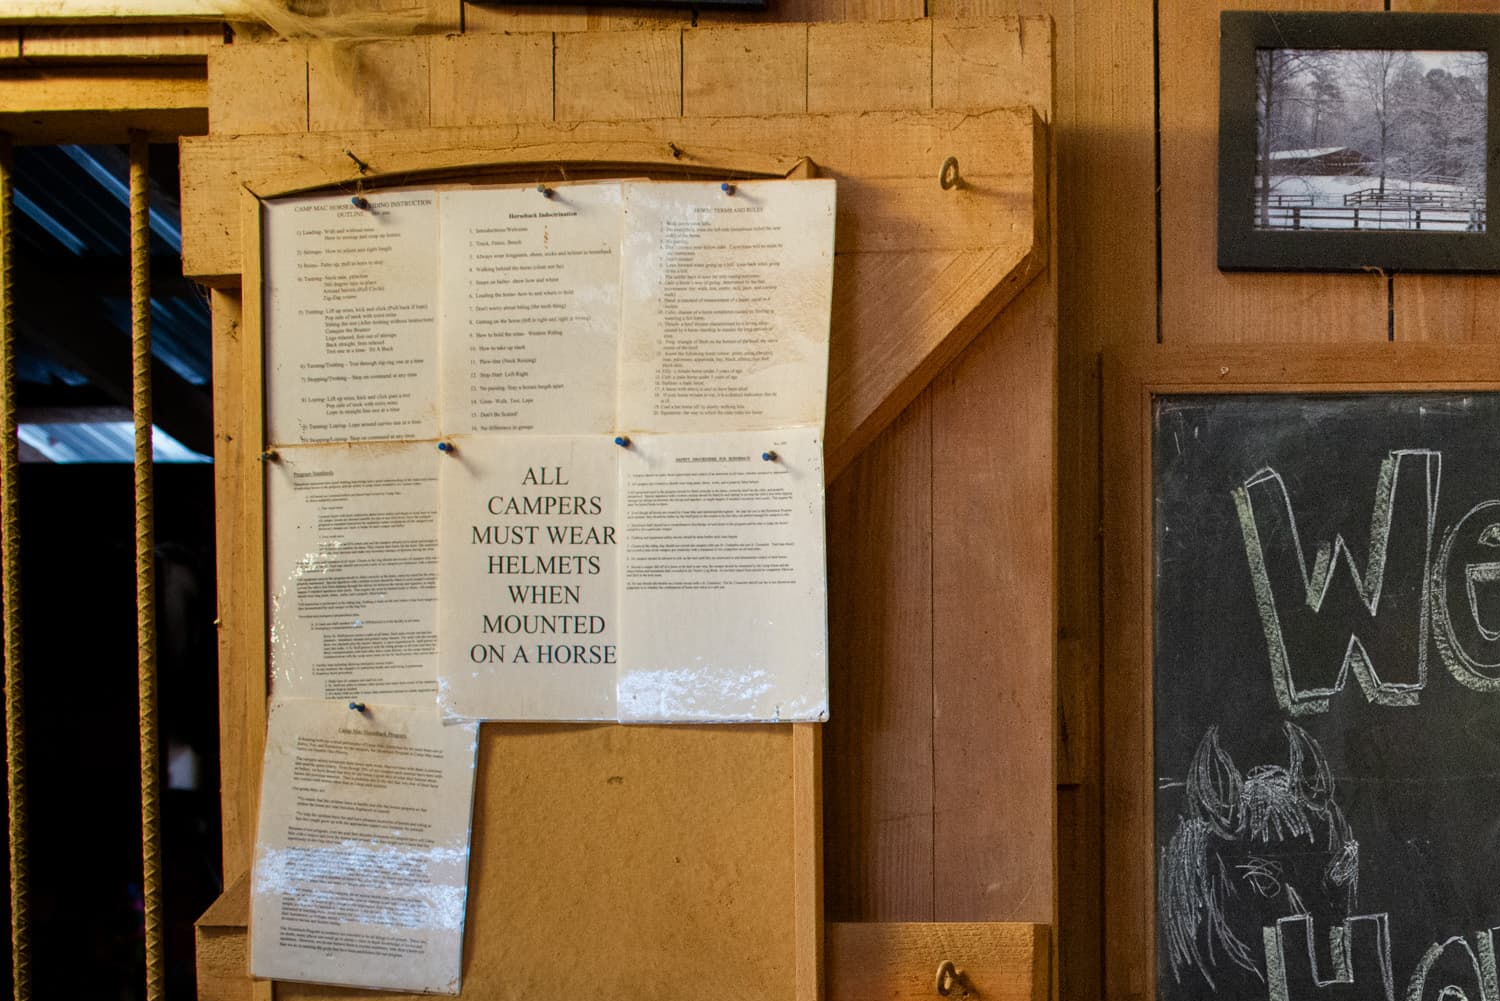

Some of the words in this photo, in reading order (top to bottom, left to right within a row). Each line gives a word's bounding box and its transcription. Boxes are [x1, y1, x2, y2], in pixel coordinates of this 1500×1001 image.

[522, 467, 569, 485] ALL
[488, 496, 602, 515] CAMPERS
[472, 526, 539, 544] MUST
[547, 526, 617, 544] WEAR
[488, 556, 600, 574] HELMETS
[508, 586, 580, 604] WHEN
[483, 615, 605, 634] MOUNTED
[471, 644, 504, 663] ON
[513, 645, 529, 663] A
[537, 645, 616, 664] HORSE
